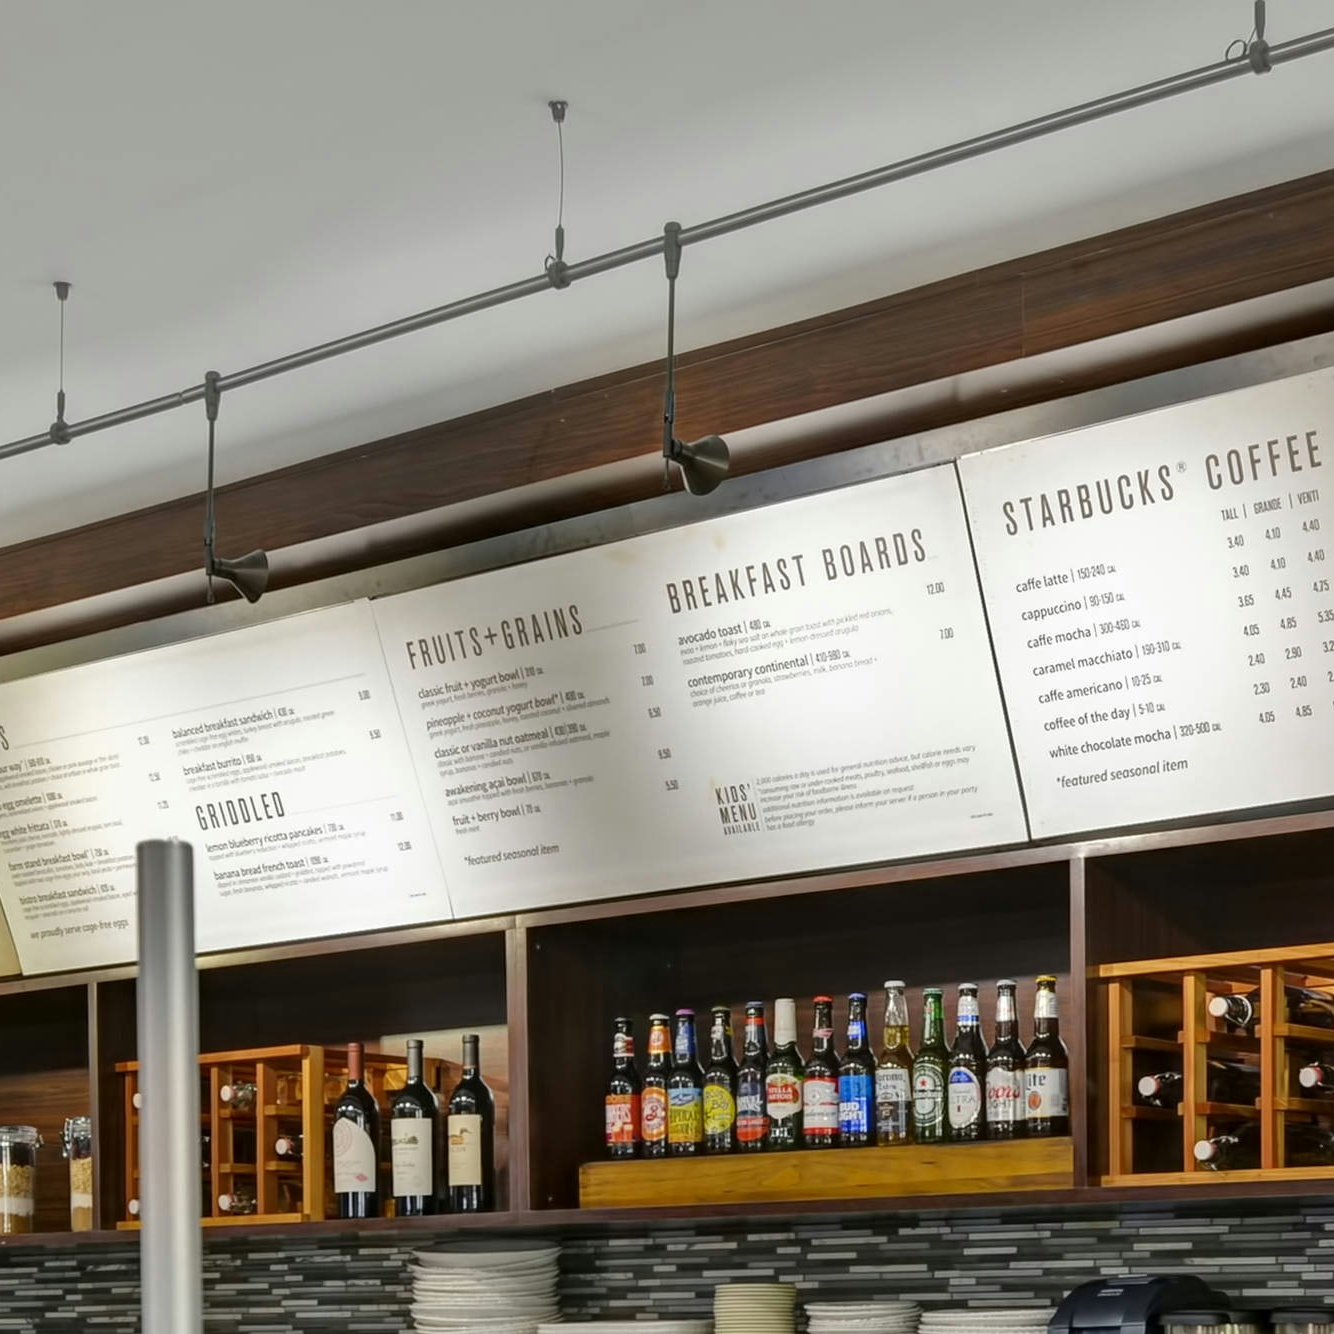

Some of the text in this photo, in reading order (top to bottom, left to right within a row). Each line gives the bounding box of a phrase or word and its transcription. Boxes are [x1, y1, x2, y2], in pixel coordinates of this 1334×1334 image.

[1205, 430, 1322, 489] COFFEE
[1220, 488, 1320, 521] TALL GRANDE VENTI
[665, 528, 925, 614] BREAKFAST BOARDS
[1015, 573, 1069, 593] caffe latte
[925, 581, 945, 595] 12.00
[1020, 600, 1082, 621] cappuccino
[406, 604, 582, 667] FRUITS+GRAINS
[677, 623, 743, 646] avocado toast
[1026, 627, 1092, 649] caffe mocha
[686, 654, 809, 688] contemporary continental
[1032, 649, 1133, 677] caramel macchiato
[417, 684, 445, 699] classic
[443, 680, 464, 693] fruit
[469, 673, 499, 691] yogurt
[497, 667, 520, 683] bowl
[1037, 680, 1123, 704] caffe americano
[171, 709, 273, 739] balanced breakfast sandwich
[425, 698, 534, 731] pineapple coconut yogurt
[1043, 707, 1130, 732] coffee of the day
[433, 727, 549, 759] classic or vanilla nut oatmeal
[1048, 728, 1172, 758] white chocolate mocha
[182, 757, 242, 776] breakfast burrito
[1109, 760, 1160, 781] seasonal
[1161, 759, 1188, 772] item
[444, 780, 489, 797] awakening
[504, 771, 528, 786] bowl
[195, 791, 285, 830] GRIDDLED
[451, 804, 521, 826] fruit berry bowl
[718, 802, 757, 824] MENU
[204, 826, 323, 853] lemon blueberry ricotta pancakes
[722, 821, 760, 836] AVAILABLE
[502, 844, 540, 861] seasonal
[539, 843, 560, 855] item
[212, 858, 306, 881] banana bread french toast
